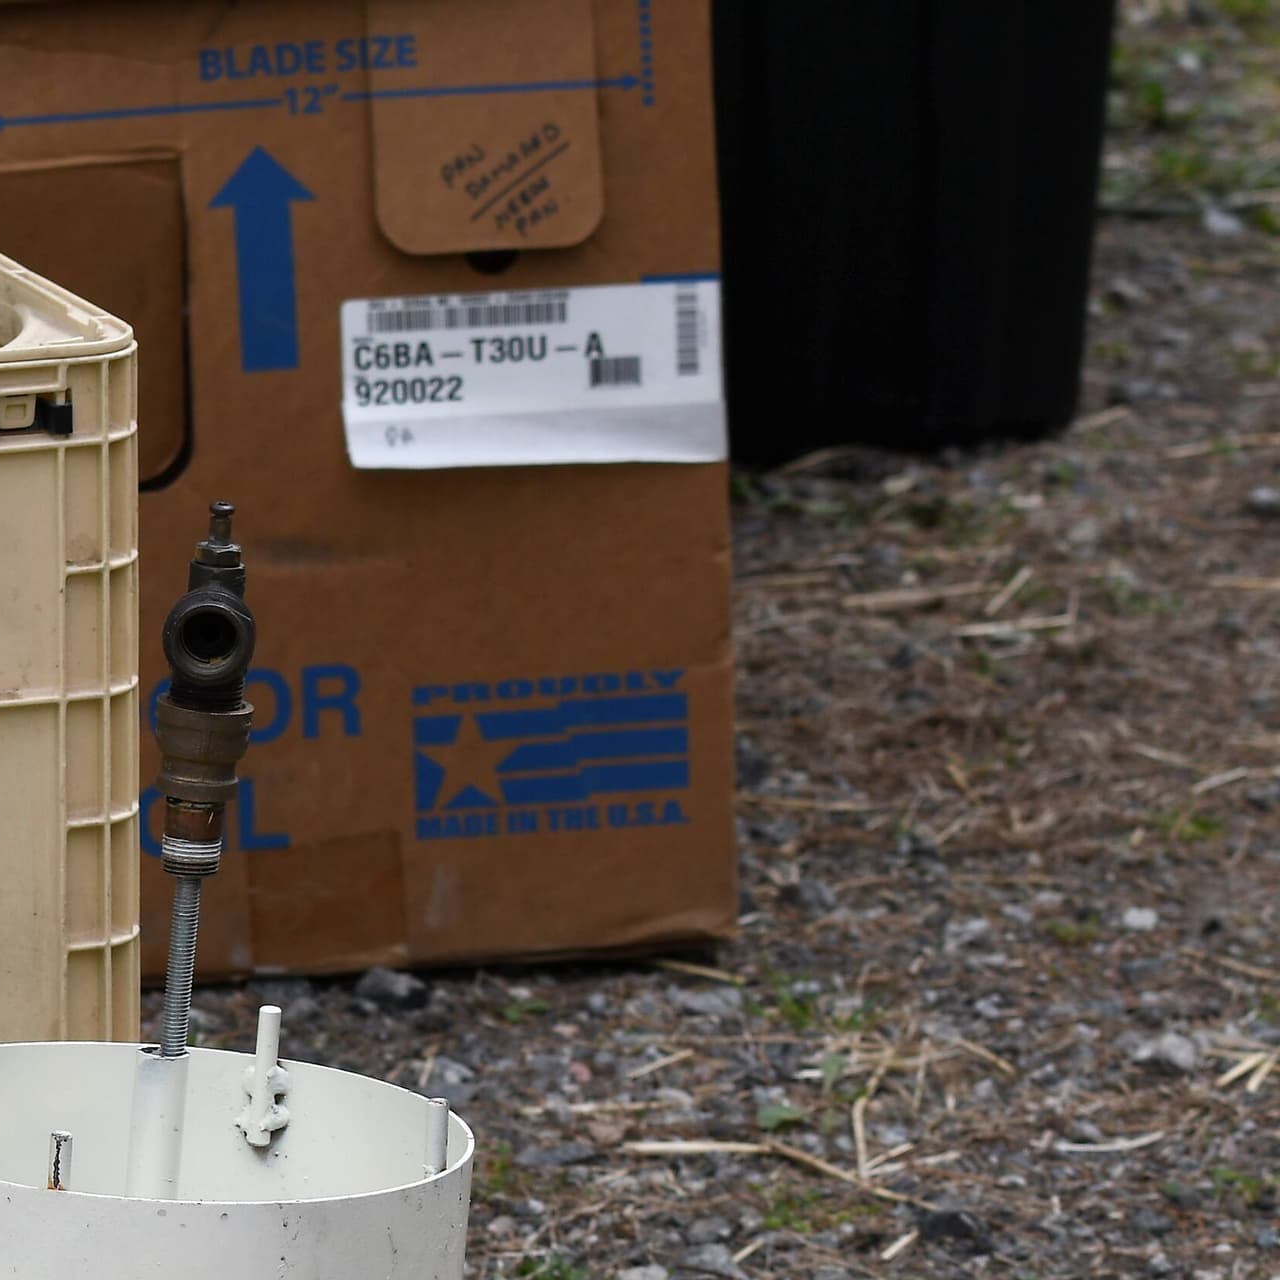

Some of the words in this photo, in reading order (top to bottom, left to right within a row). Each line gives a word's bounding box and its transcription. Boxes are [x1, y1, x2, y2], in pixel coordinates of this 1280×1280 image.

[199, 43, 324, 81] BLADE
[335, 35, 417, 71] SIZE
[355, 376, 463, 407] 920022
[411, 669, 685, 705] PROUDLY
[415, 814, 498, 841] MADE
[506, 810, 538, 836] IN
[548, 806, 600, 832] THE
